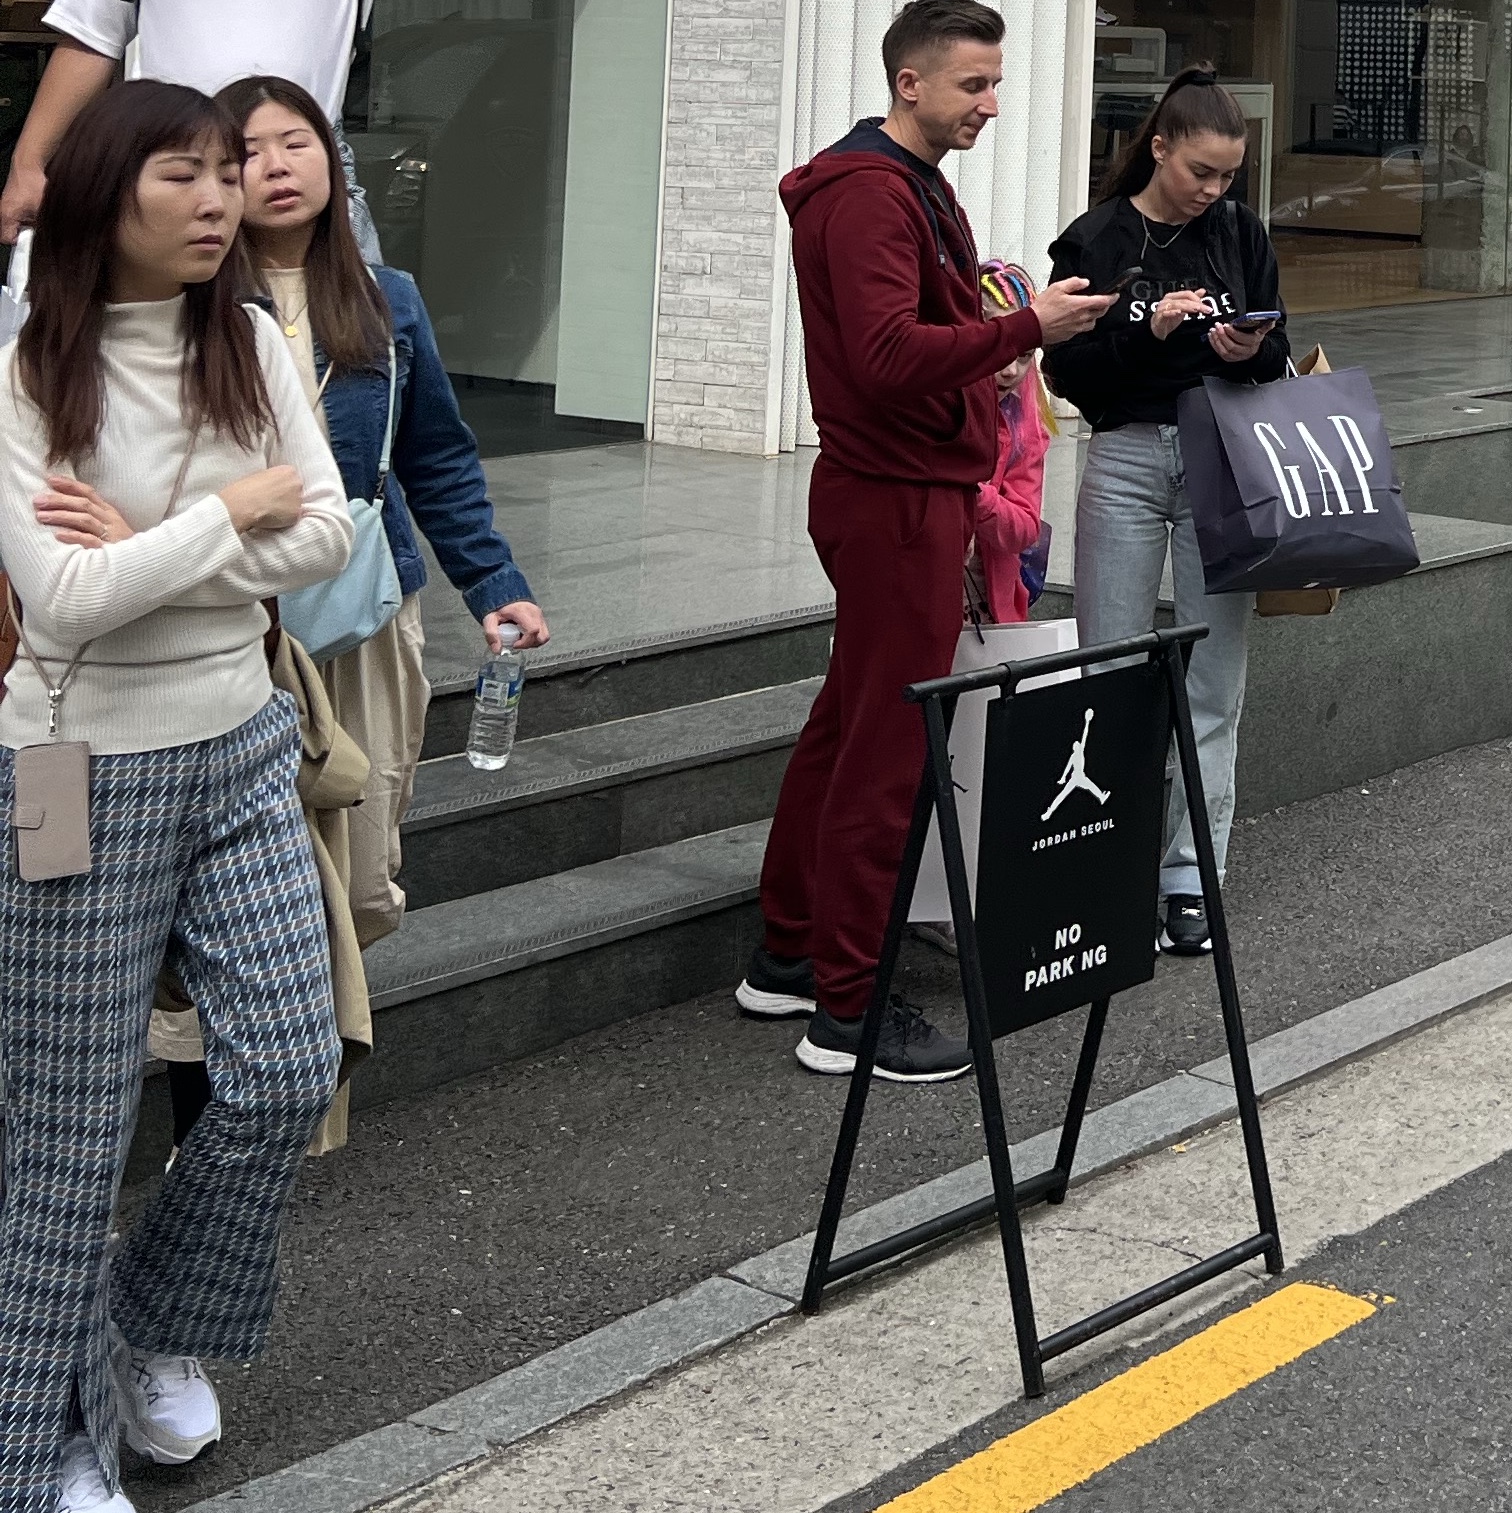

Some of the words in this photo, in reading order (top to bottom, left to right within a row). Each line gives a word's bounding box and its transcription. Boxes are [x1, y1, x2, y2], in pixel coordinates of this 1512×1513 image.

[1253, 415, 1379, 519] GAP
[1032, 829, 1077, 852] JORDAN
[1081, 818, 1115, 837] SEOUL
[1054, 923, 1082, 951] NO
